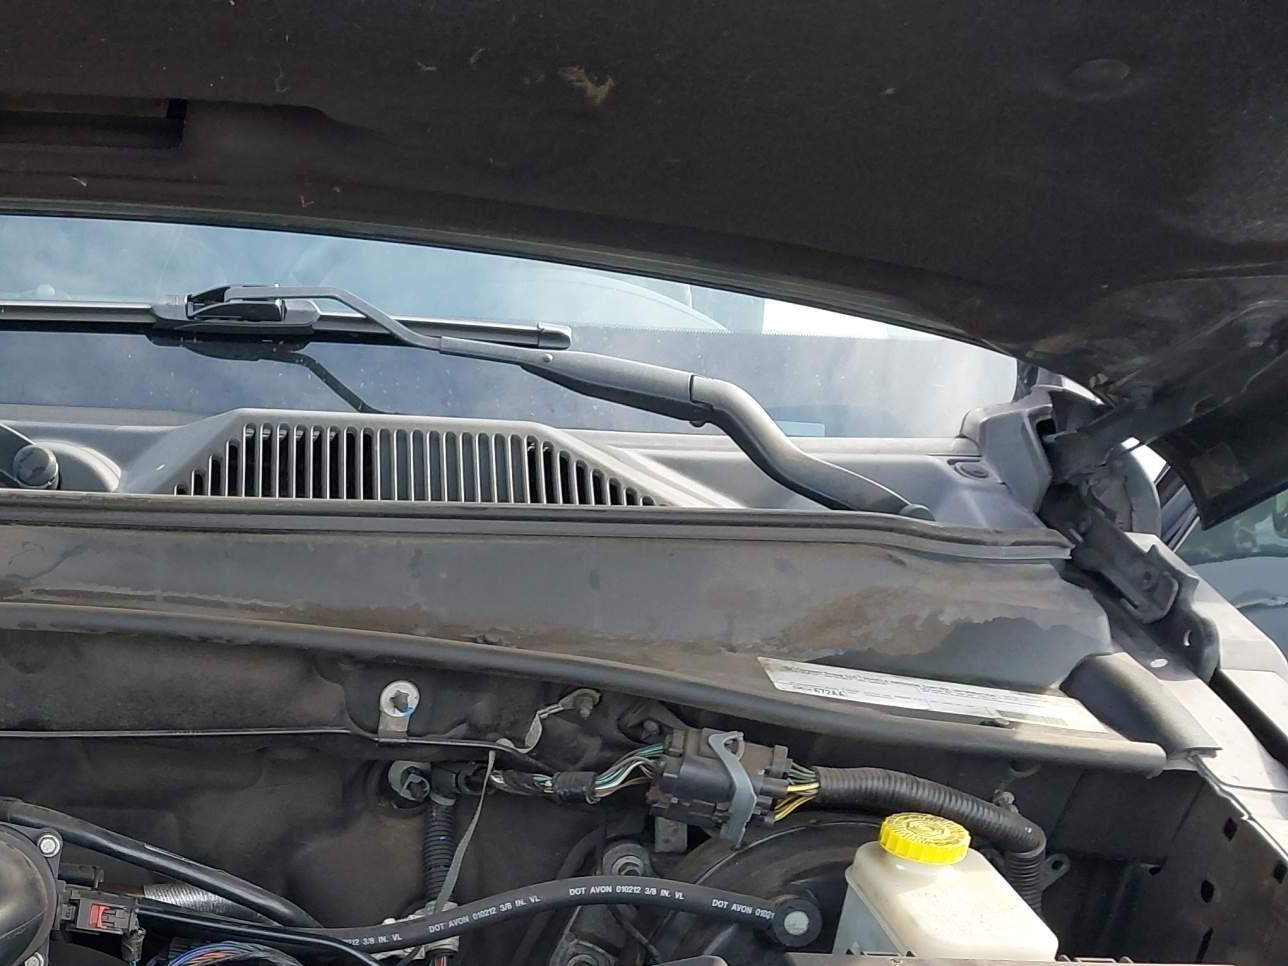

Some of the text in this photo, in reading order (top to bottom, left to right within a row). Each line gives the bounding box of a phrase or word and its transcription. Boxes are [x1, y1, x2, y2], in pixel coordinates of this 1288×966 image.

[569, 887, 586, 896] DOT
[589, 885, 612, 895] AVON
[712, 898, 729, 909] DOT
[731, 902, 753, 914] AVON
[428, 922, 446, 934] DOT
[448, 914, 470, 928] AVON
